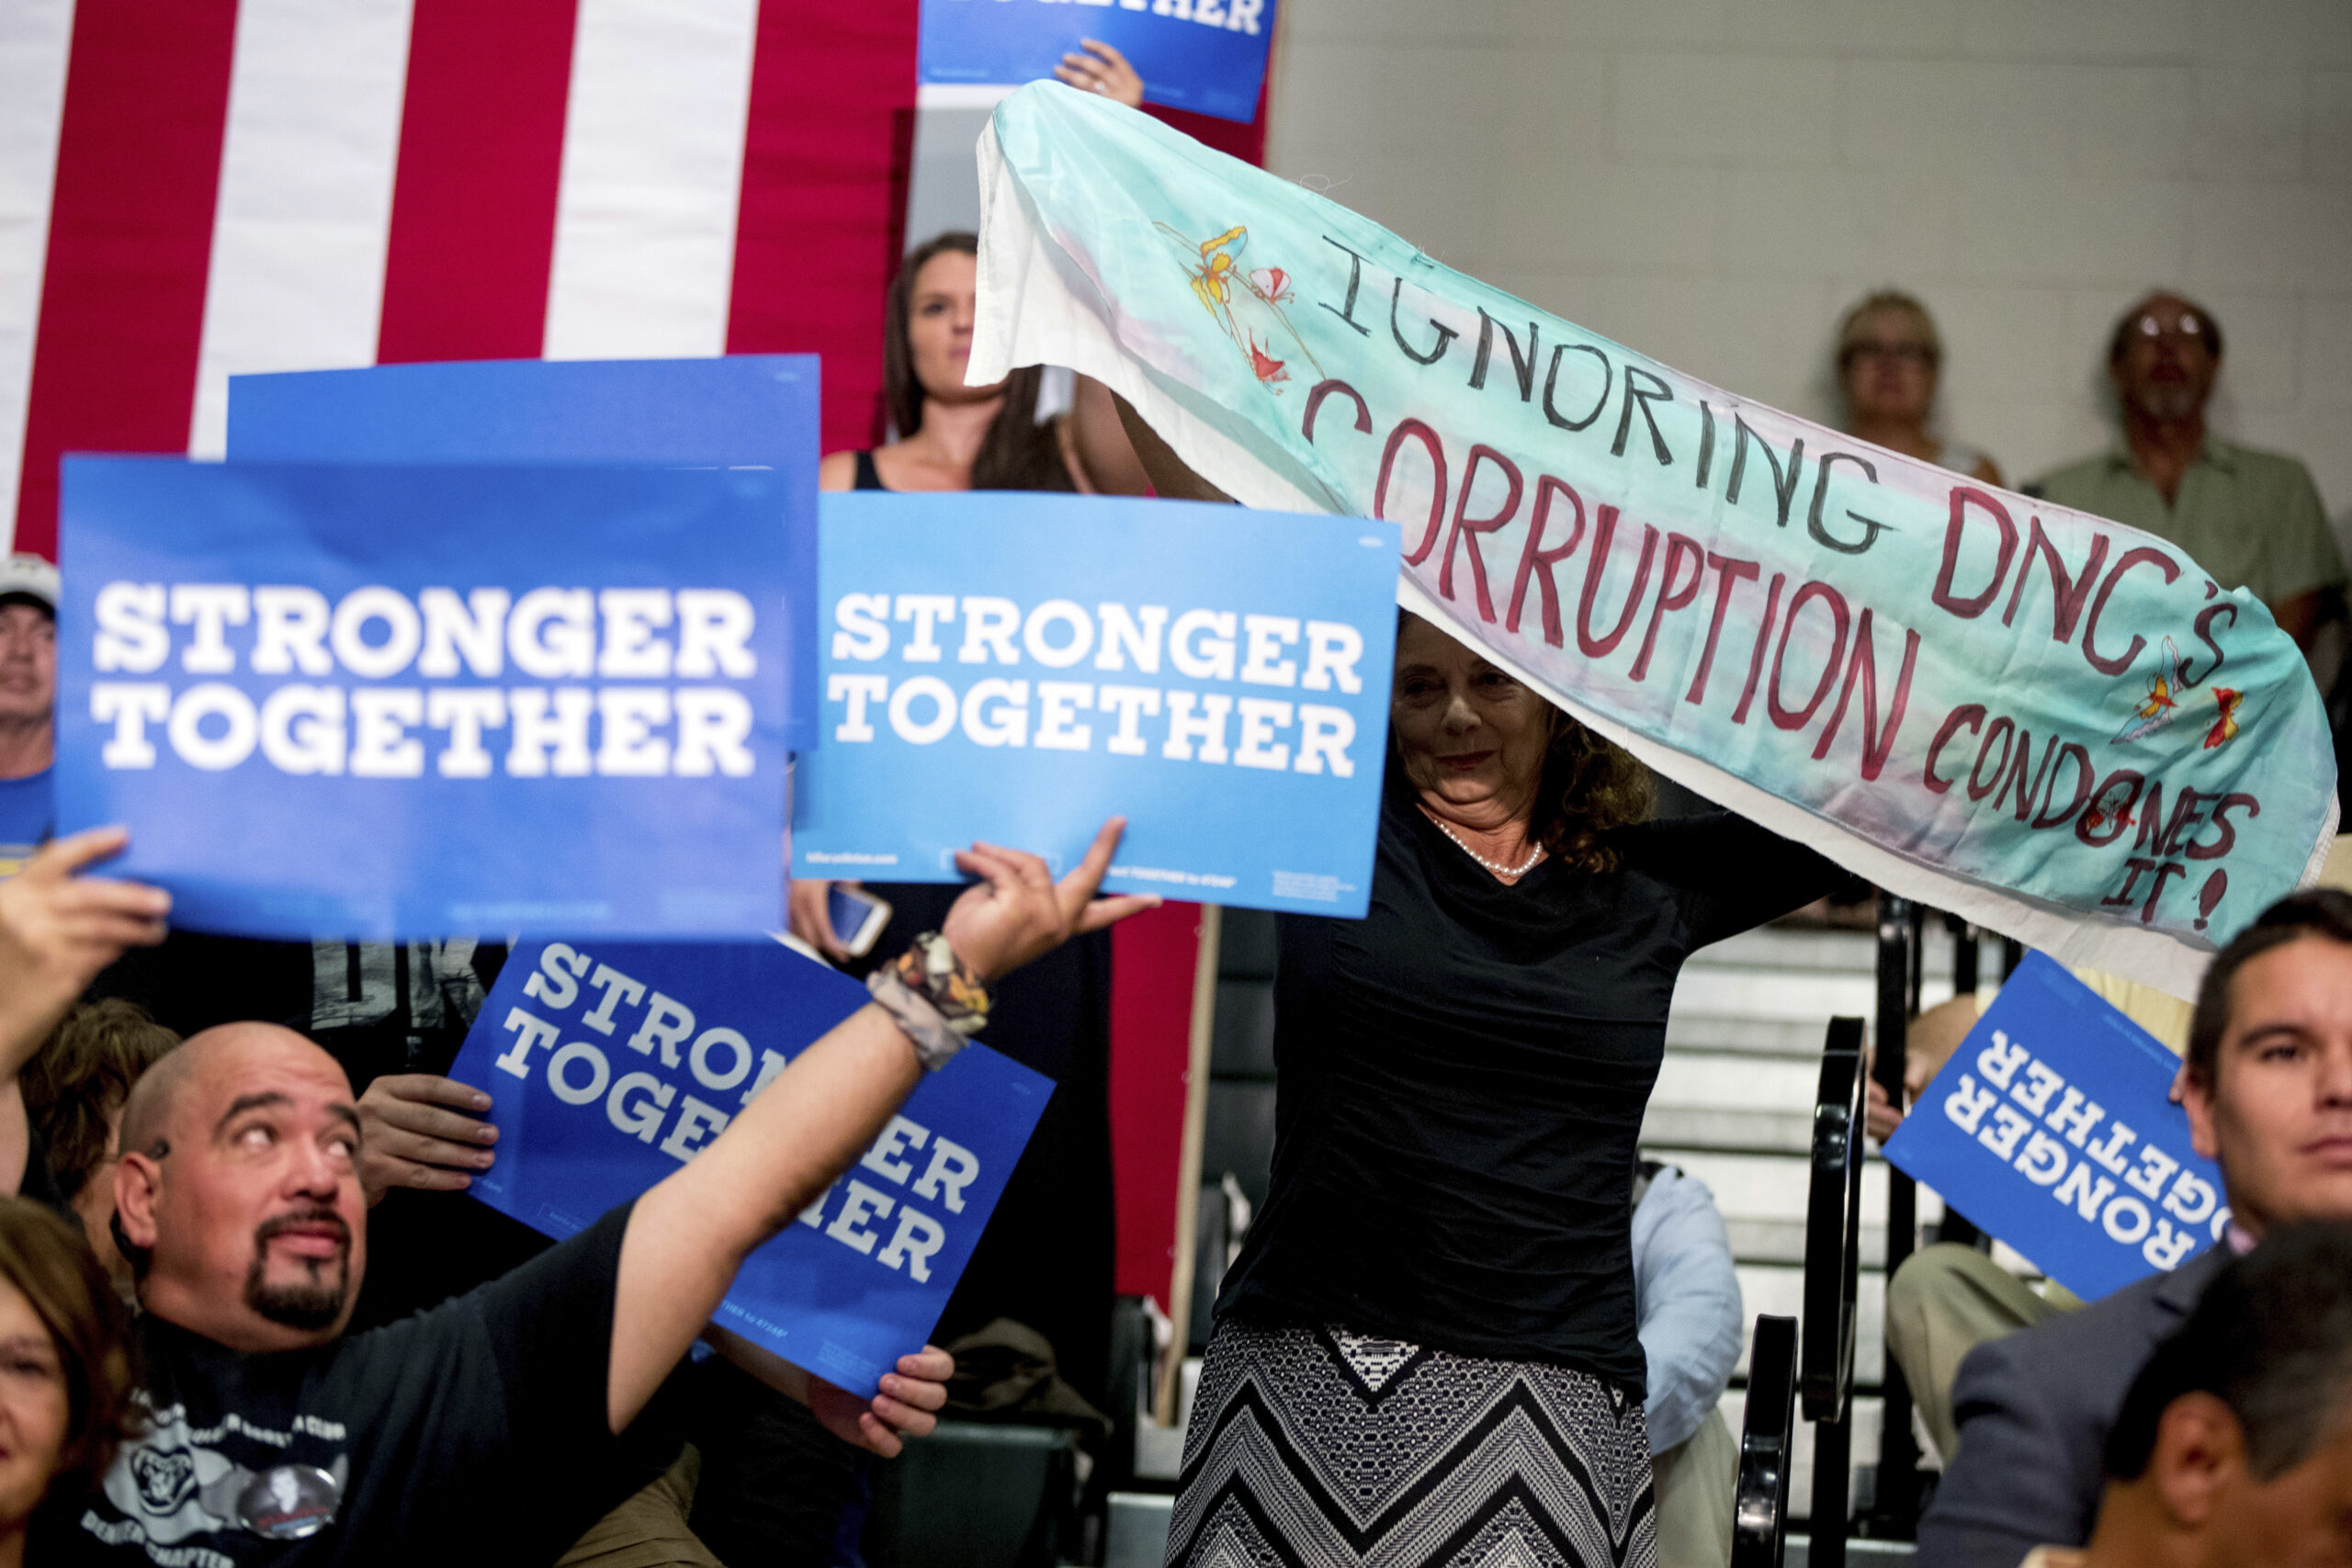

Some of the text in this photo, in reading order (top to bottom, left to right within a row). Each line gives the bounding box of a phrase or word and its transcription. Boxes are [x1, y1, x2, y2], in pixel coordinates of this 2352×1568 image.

[1319, 235, 2238, 689] IGNORING DNC'S
[94, 581, 758, 678] STRONGER
[831, 593, 1363, 694] STRONGER
[1302, 378, 2260, 860] CORRUPTION CONDONES
[89, 682, 756, 778] TOGETHER
[828, 674, 1357, 778] TOGETHER
[494, 1007, 945, 1284] TOGEER
[523, 942, 979, 1214] STROER
[1944, 1074, 2196, 1272] RONGER
[1977, 1030, 2233, 1242] GETHER
